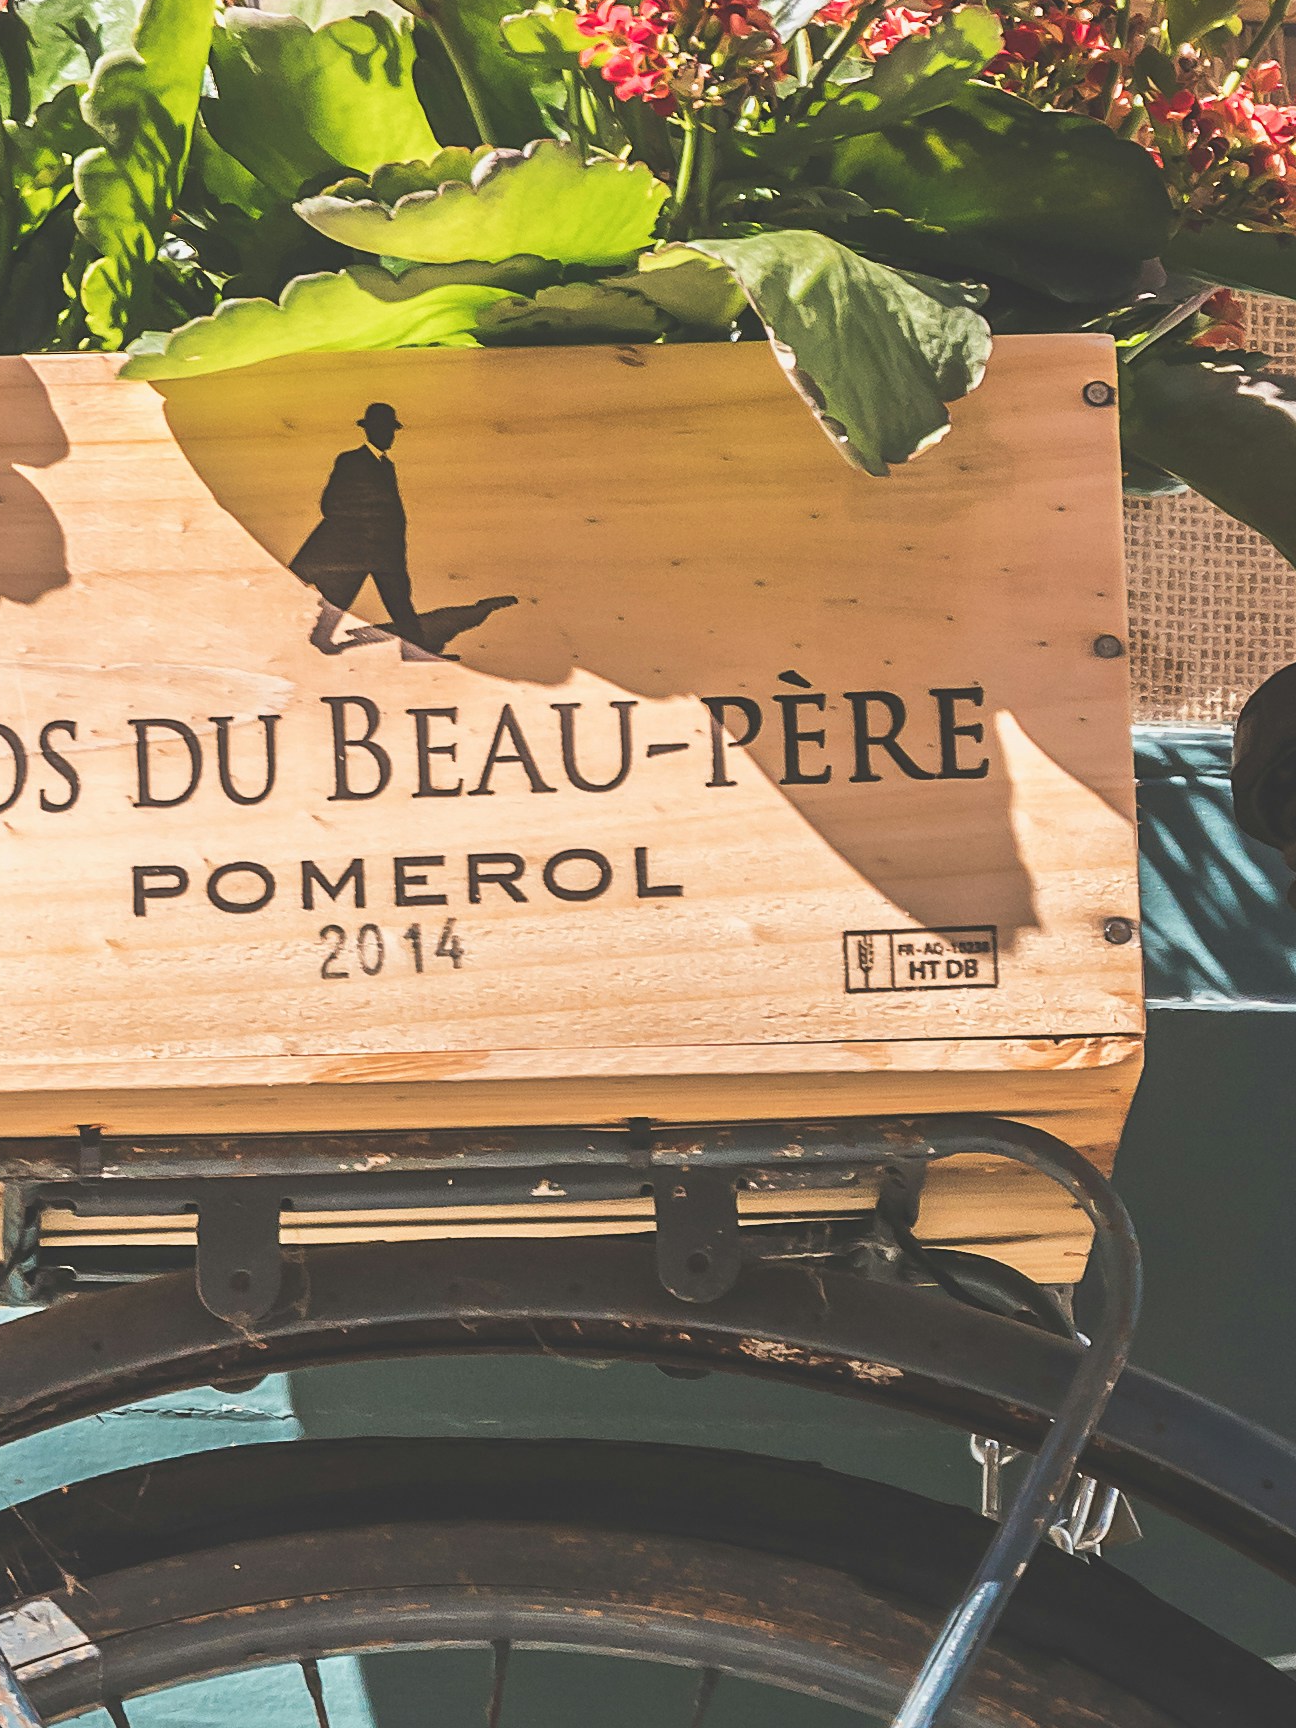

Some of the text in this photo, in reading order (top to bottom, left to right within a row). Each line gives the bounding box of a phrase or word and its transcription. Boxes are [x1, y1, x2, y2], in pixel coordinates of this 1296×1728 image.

[127, 714, 282, 808] DU
[320, 670, 991, 801] BEAU-PÈRE
[132, 846, 684, 917] POMEROL
[319, 917, 465, 980] 2014
